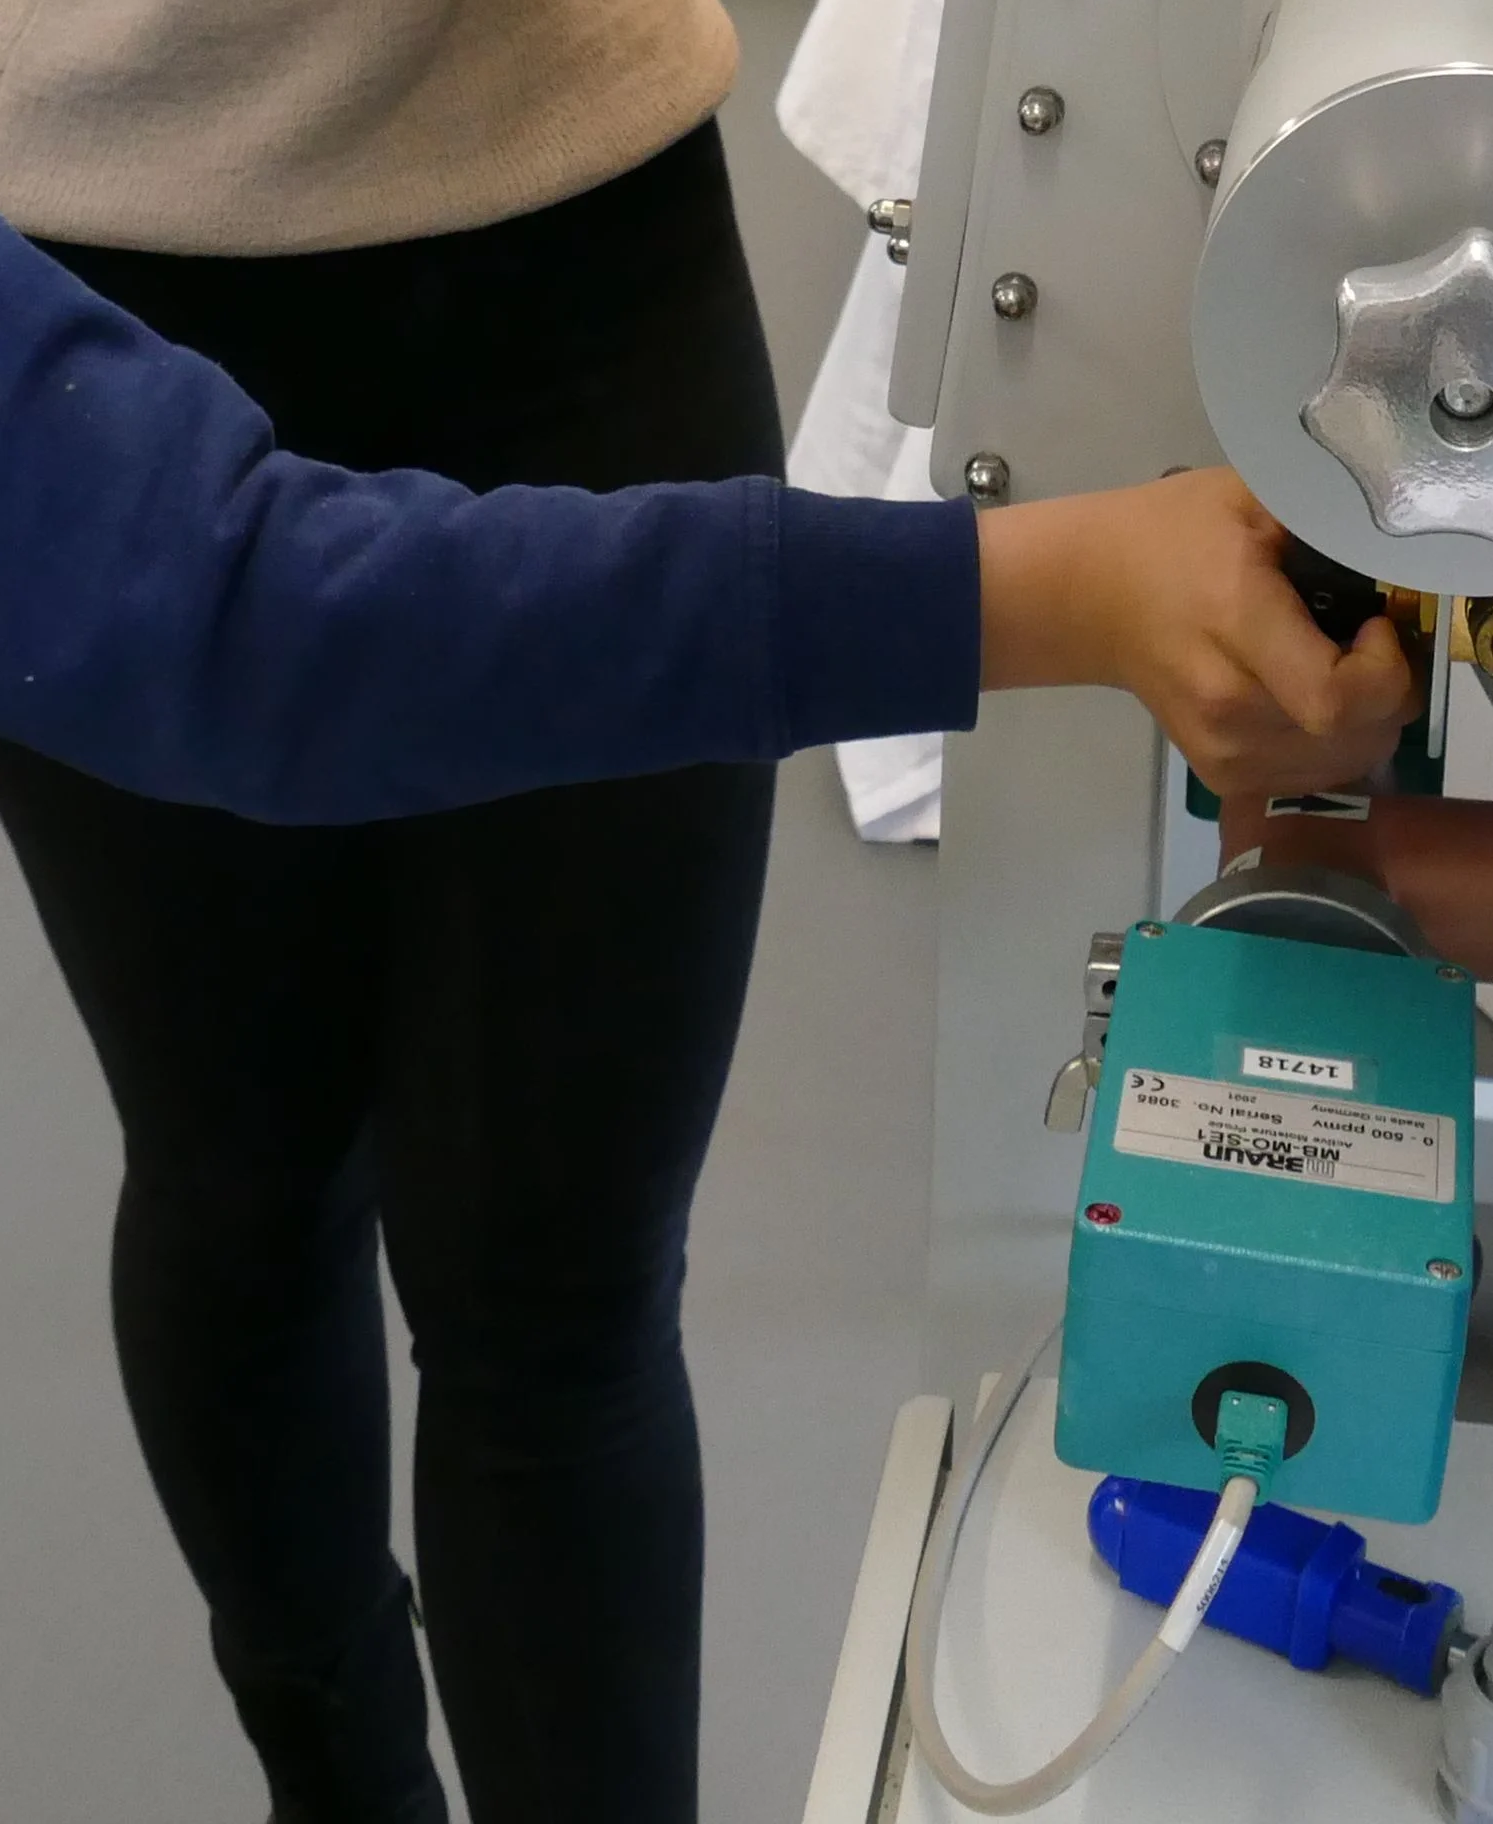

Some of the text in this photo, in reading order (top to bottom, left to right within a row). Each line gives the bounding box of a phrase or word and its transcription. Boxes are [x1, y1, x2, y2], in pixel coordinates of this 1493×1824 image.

[1258, 1054, 1339, 1078] 14718
[1193, 1101, 1224, 1116] No.
[1230, 1106, 1283, 1125] Serial
[1311, 1103, 1371, 1121] Germany
[1312, 1118, 1366, 1135] ppmv
[1390, 1115, 1426, 1129] Made
[1208, 1119, 1353, 1149] Active Moisture Probe
[1371, 1129, 1404, 1143] 500
[1196, 1128, 1340, 1162] MB-MO-SE1
